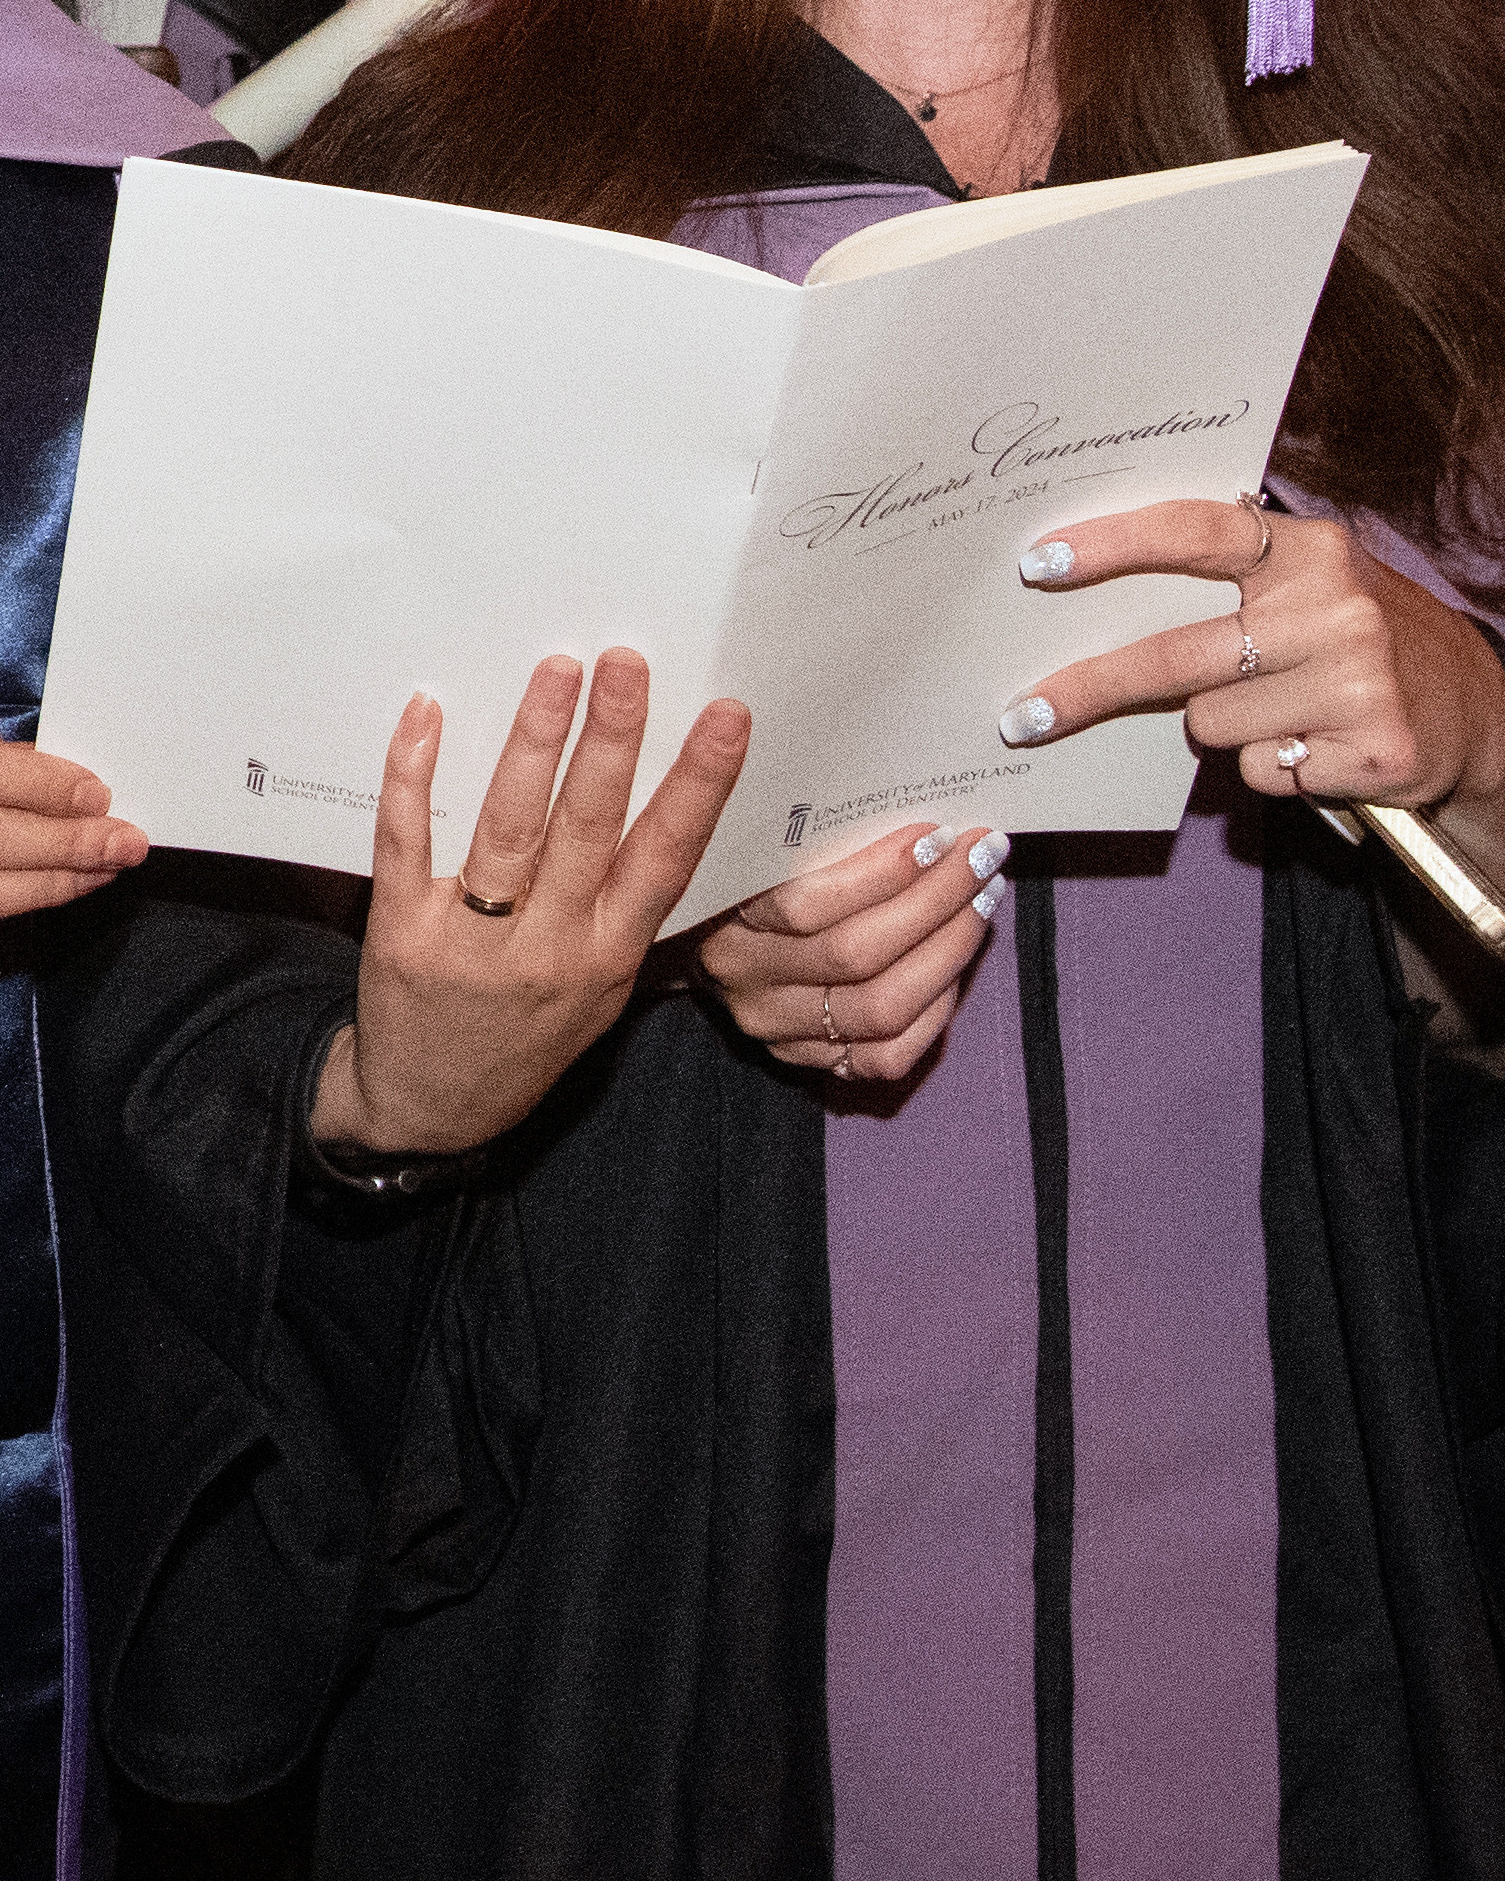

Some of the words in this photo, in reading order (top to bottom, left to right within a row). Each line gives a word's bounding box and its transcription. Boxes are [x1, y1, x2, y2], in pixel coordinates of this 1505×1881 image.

[779, 461, 974, 550] Honors
[971, 399, 1250, 478] Convocation
[926, 507, 965, 532] MAY
[1004, 479, 1051, 504] 2024
[271, 786, 319, 801] SCHOOL
[323, 794, 339, 804] OF
[272, 776, 356, 799] UNIVERSITY
[812, 808, 866, 832] SCHOOL
[872, 801, 889, 815] OF
[897, 783, 976, 809] DENTISTRY
[814, 784, 913, 822] UNIVERSITY
[929, 763, 1030, 789] MARYLAND
